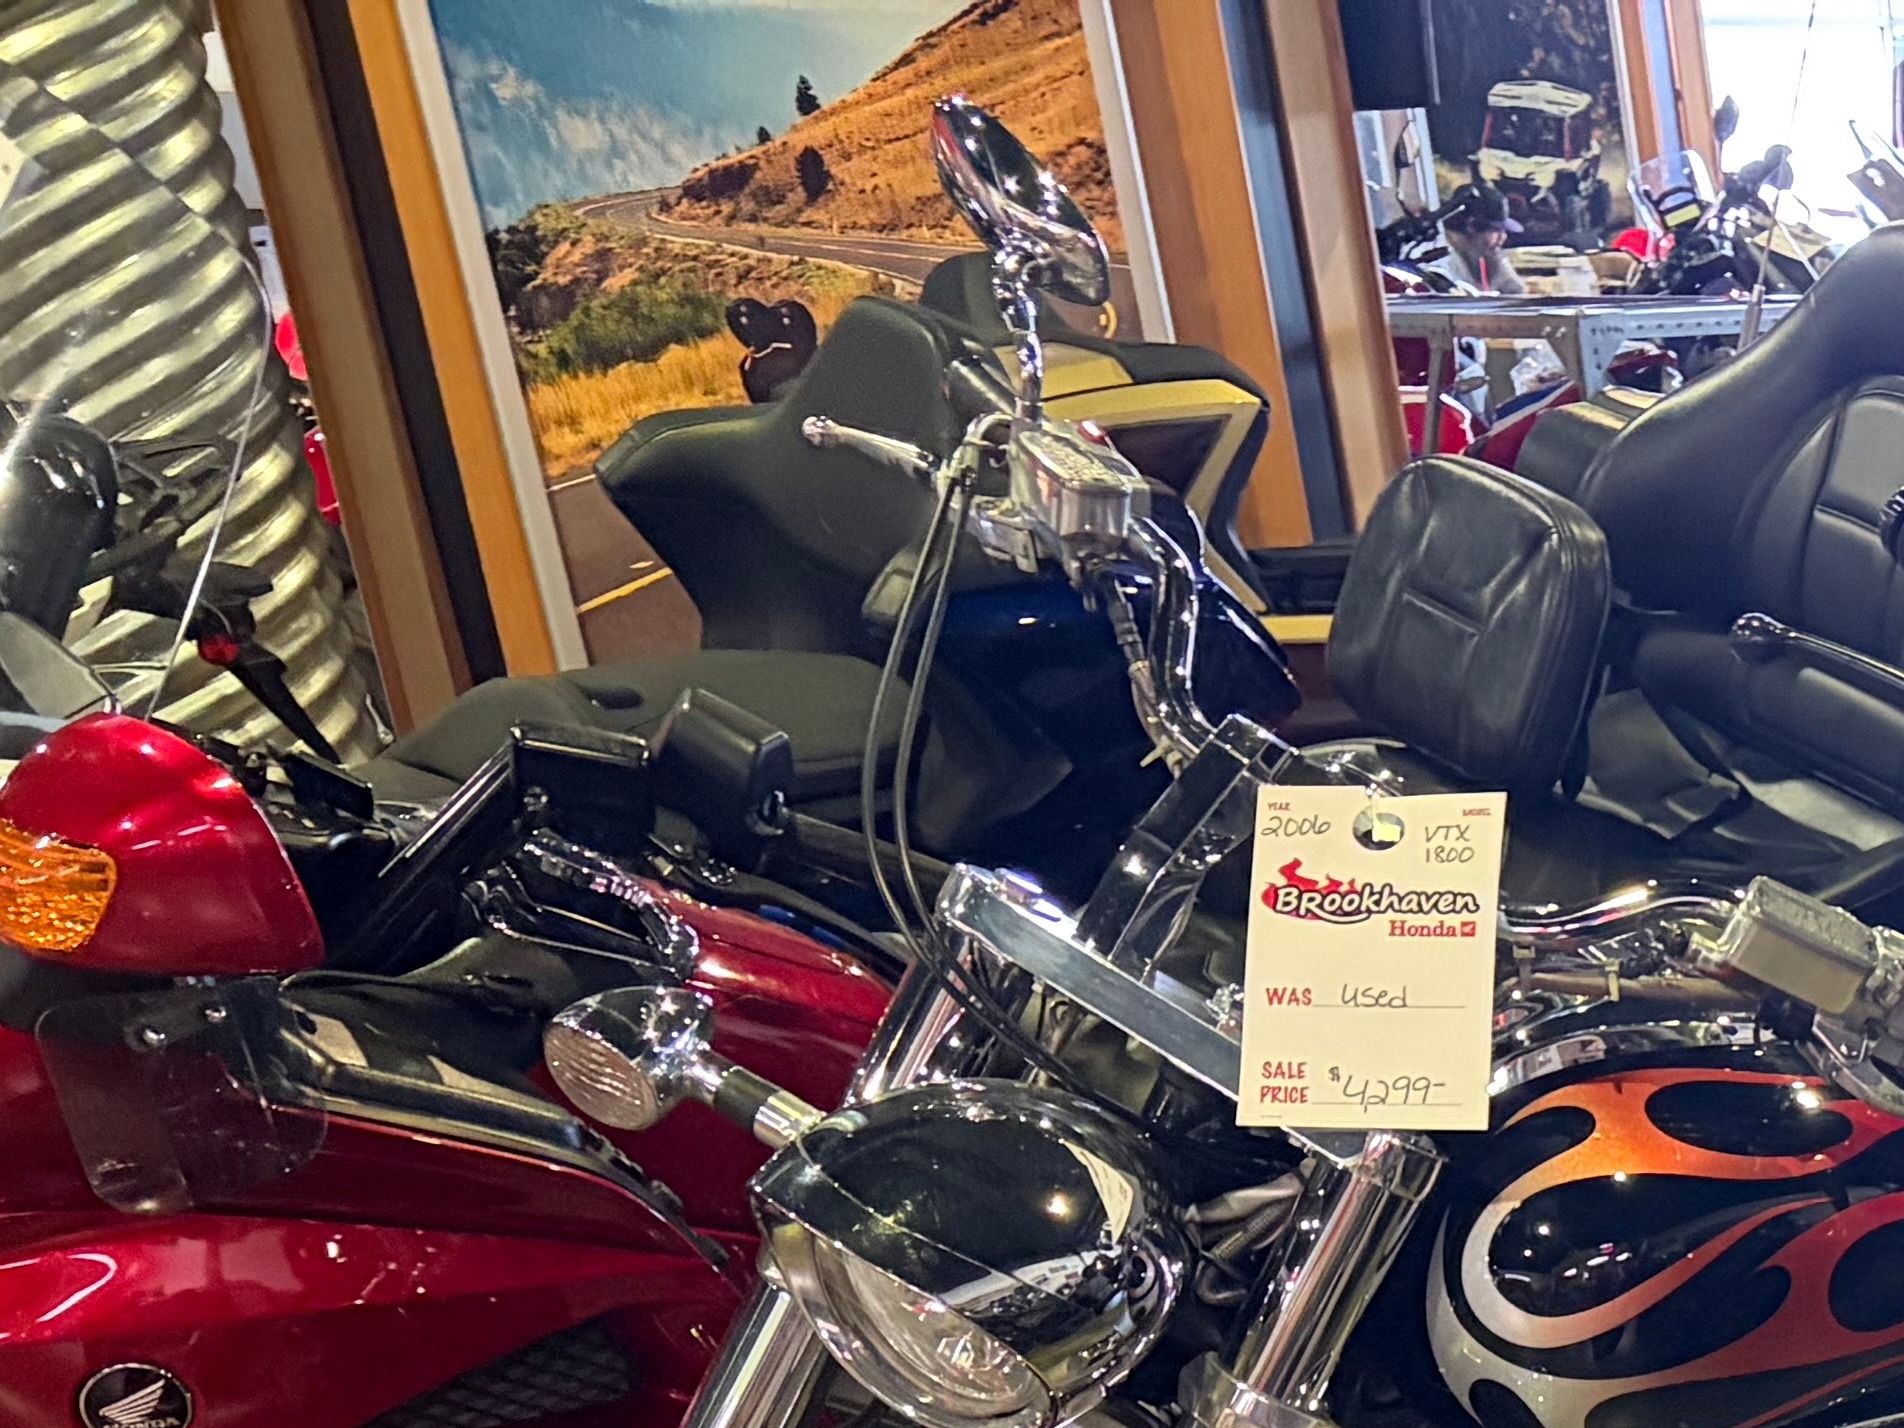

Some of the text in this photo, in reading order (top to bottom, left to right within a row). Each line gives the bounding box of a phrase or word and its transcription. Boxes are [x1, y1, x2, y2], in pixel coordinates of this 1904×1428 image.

[1260, 814, 1332, 838] 2006
[1424, 823, 1471, 843] VTX
[1425, 845, 1475, 864] 1800
[1388, 920, 1458, 938] Honda
[1265, 986, 1312, 1006] WAS
[1261, 1061, 1308, 1080] SALE
[1259, 1086, 1310, 1104] PRICE
